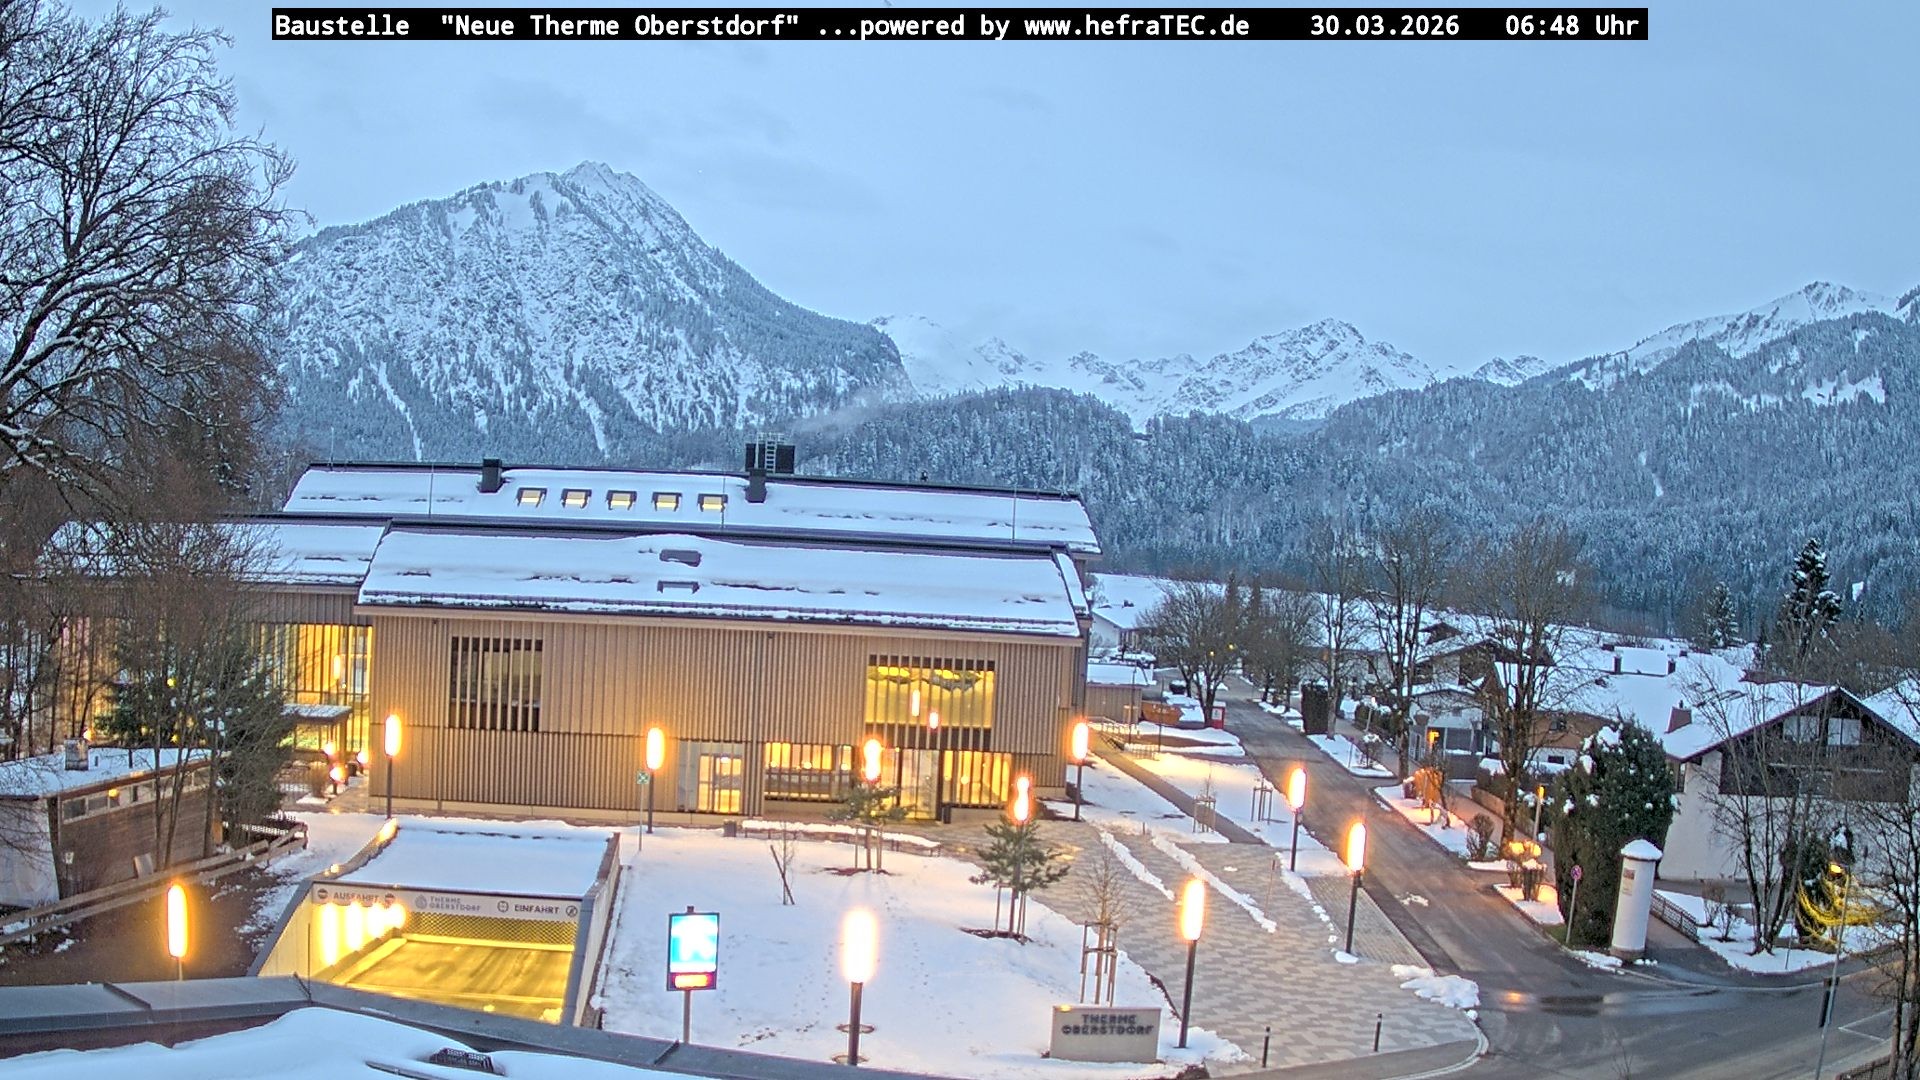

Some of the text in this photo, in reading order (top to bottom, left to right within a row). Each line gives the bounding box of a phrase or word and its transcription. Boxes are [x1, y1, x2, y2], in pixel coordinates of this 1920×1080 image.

[514, 903, 560, 914] EINFAHRT
[1082, 1014, 1136, 1024] THERME
[1062, 1025, 1154, 1035] OBERSTDORF
